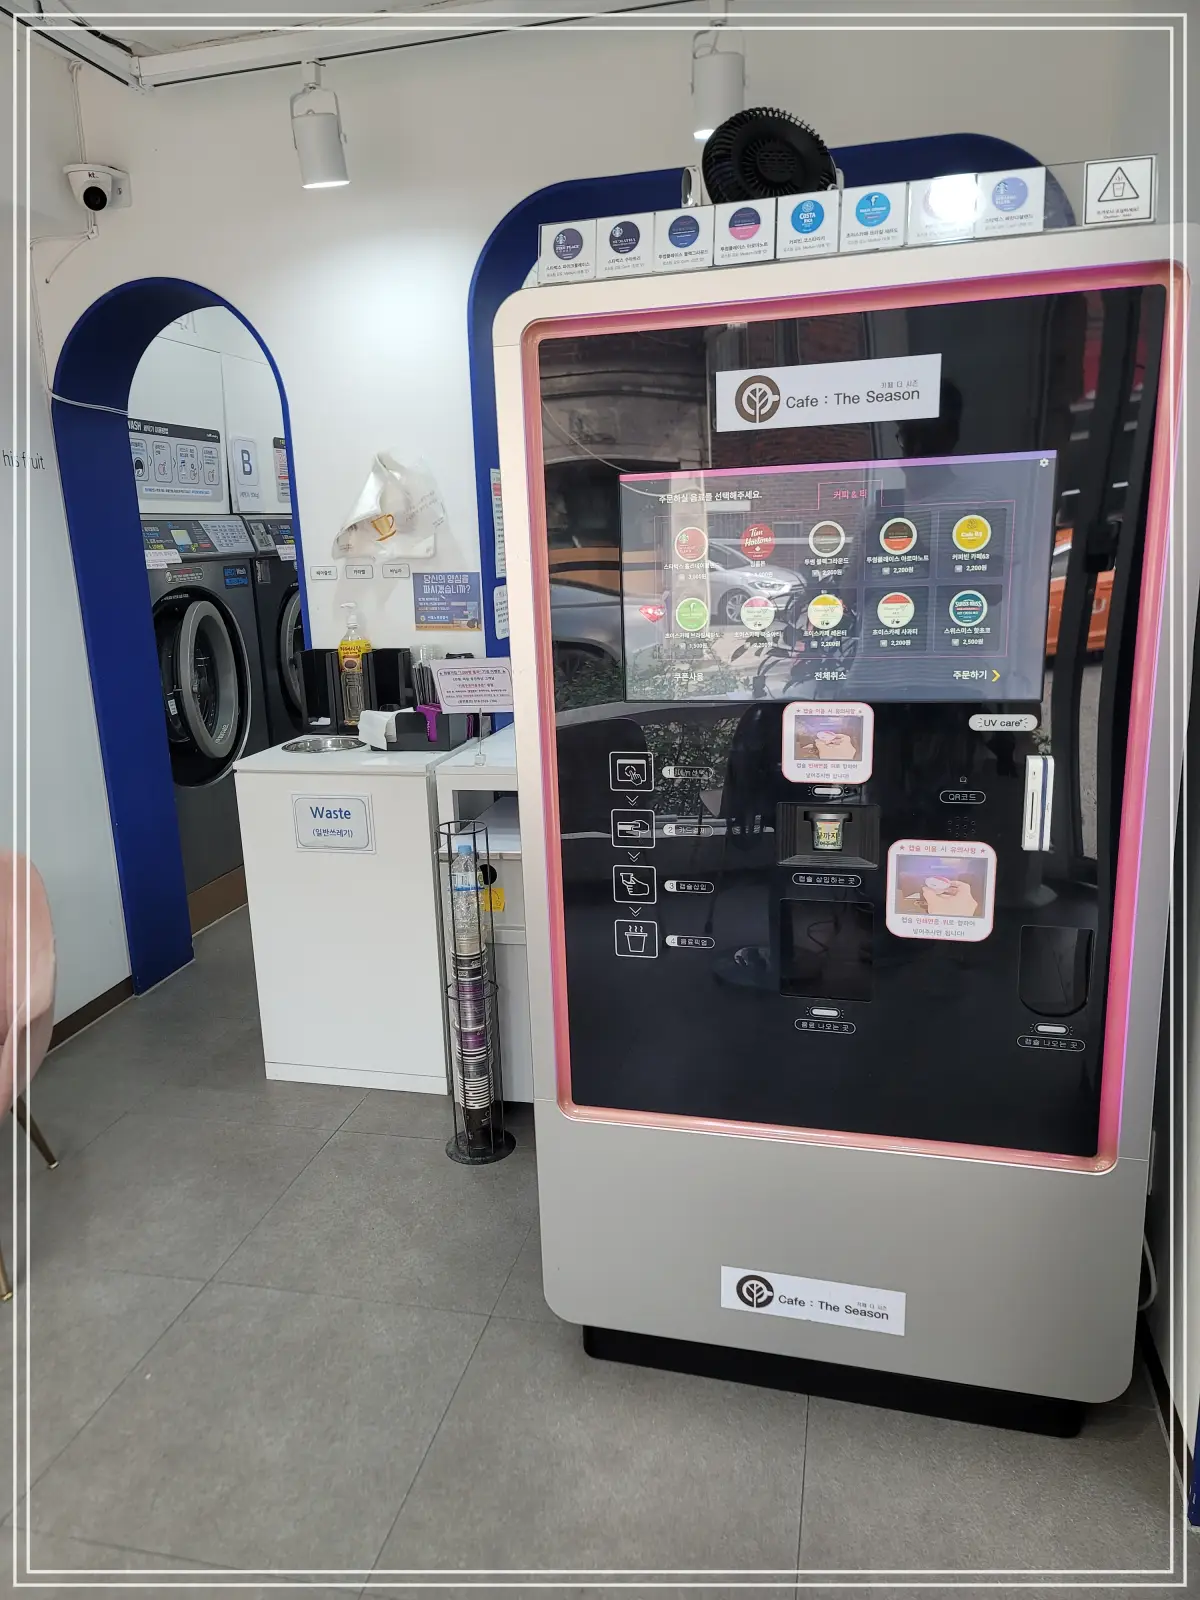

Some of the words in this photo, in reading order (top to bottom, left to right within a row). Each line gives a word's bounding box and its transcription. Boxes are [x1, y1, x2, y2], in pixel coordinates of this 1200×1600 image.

[786, 395, 819, 409] Cafe
[834, 392, 860, 406] The
[866, 389, 920, 403] Season
[22, 451, 45, 470] fuit
[241, 449, 252, 475] B
[659, 493, 690, 503] 주문하실
[714, 490, 762, 501] 선택해주세요.
[833, 489, 849, 500] 커피
[851, 490, 858, 498] &
[749, 527, 763, 537] Tim
[744, 536, 772, 547] Hortons
[423, 575, 446, 584] 당신의
[813, 671, 847, 681] 전체취소
[953, 670, 988, 681] 주문하기
[984, 719, 998, 727] UV
[948, 793, 977, 802] QR코드
[309, 806, 352, 820] Waste
[312, 828, 354, 838] (일반쓰레기)
[818, 1023, 840, 1031] 나오는
[1043, 1039, 1067, 1048] 나오는
[778, 1294, 806, 1307] Cafe
[818, 1300, 840, 1313] The
[844, 1304, 889, 1320] Season
